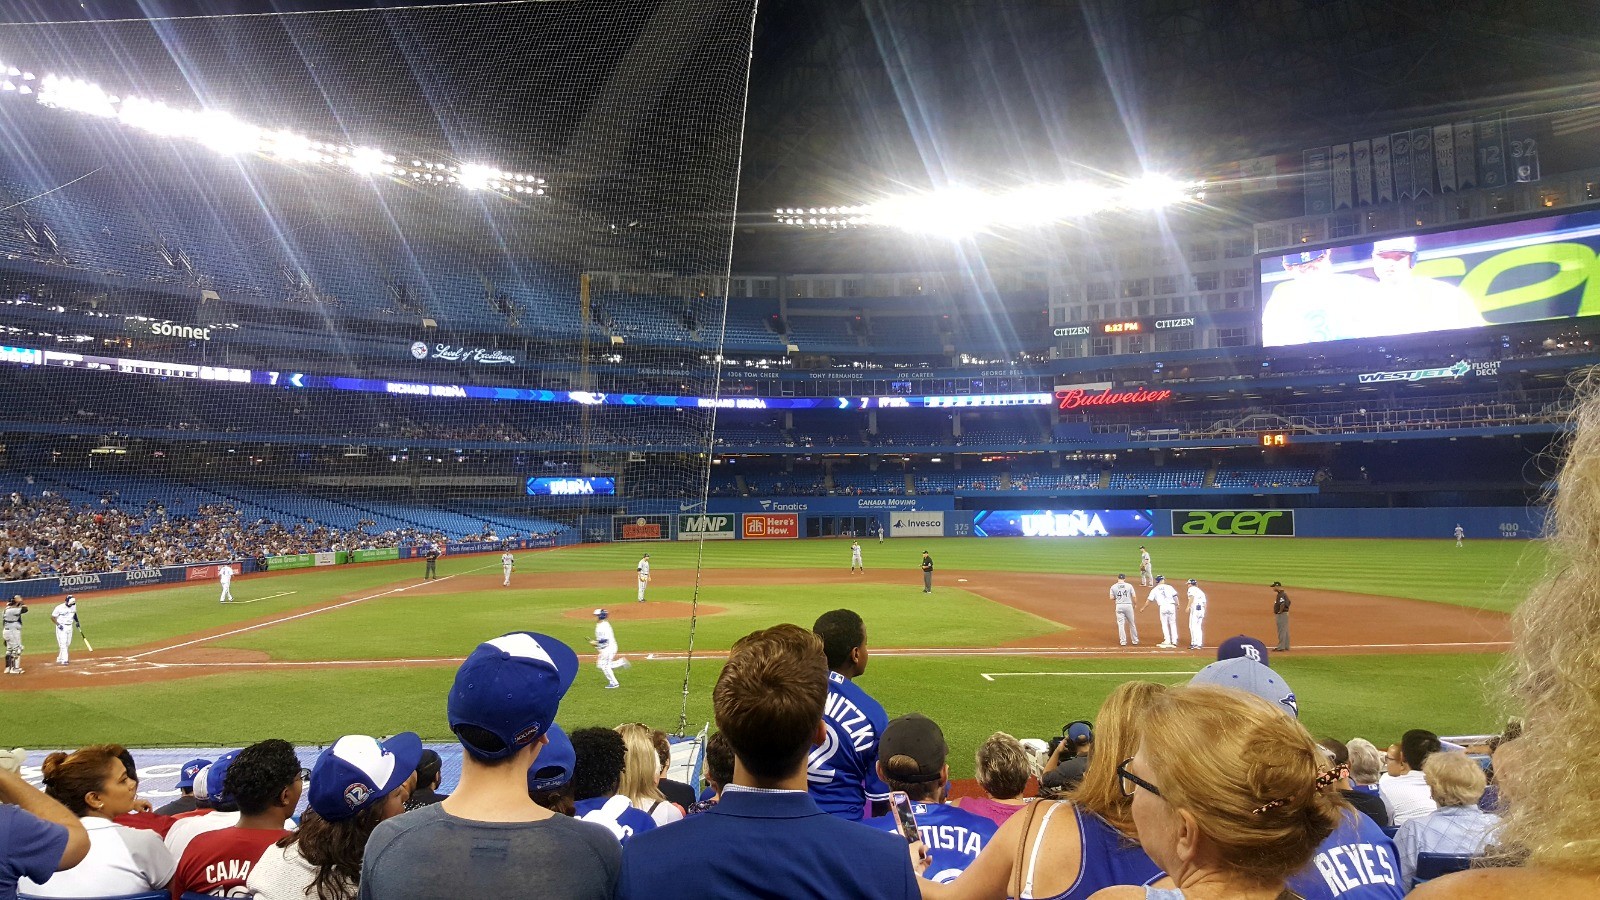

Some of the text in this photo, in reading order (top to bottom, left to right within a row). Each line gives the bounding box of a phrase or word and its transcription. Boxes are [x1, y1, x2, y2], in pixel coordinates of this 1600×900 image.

[1510, 138, 1536, 157] 32
[1124, 322, 1138, 331] PM
[1155, 318, 1195, 329] CITIZEN
[1053, 326, 1090, 337] CITIZEN
[431, 343, 516, 364] Level of Excellence
[269, 371, 279, 385] 7
[1359, 361, 1502, 382] WESTJET FLIGHT
[1475, 368, 1498, 376] DECK
[860, 397, 869, 409] 7
[1055, 386, 1171, 409] Budweiser
[772, 502, 808, 511] Fanatics
[857, 498, 917, 506] CANADA MOVING
[685, 516, 728, 532] MNP
[766, 518, 795, 526] Here's
[908, 519, 941, 528] Invesco
[954, 523, 970, 531] 375
[1182, 511, 1283, 535] acer
[1499, 522, 1519, 531] 400
[59, 574, 101, 587] HONDA
[126, 569, 162, 581] HONDA
[1240, 644, 1261, 662] TB
[807, 722, 839, 783] 2
[345, 787, 368, 803] 12
[917, 825, 982, 859] TISTA
[205, 859, 251, 883] CANA
[1313, 843, 1396, 898] REYES
